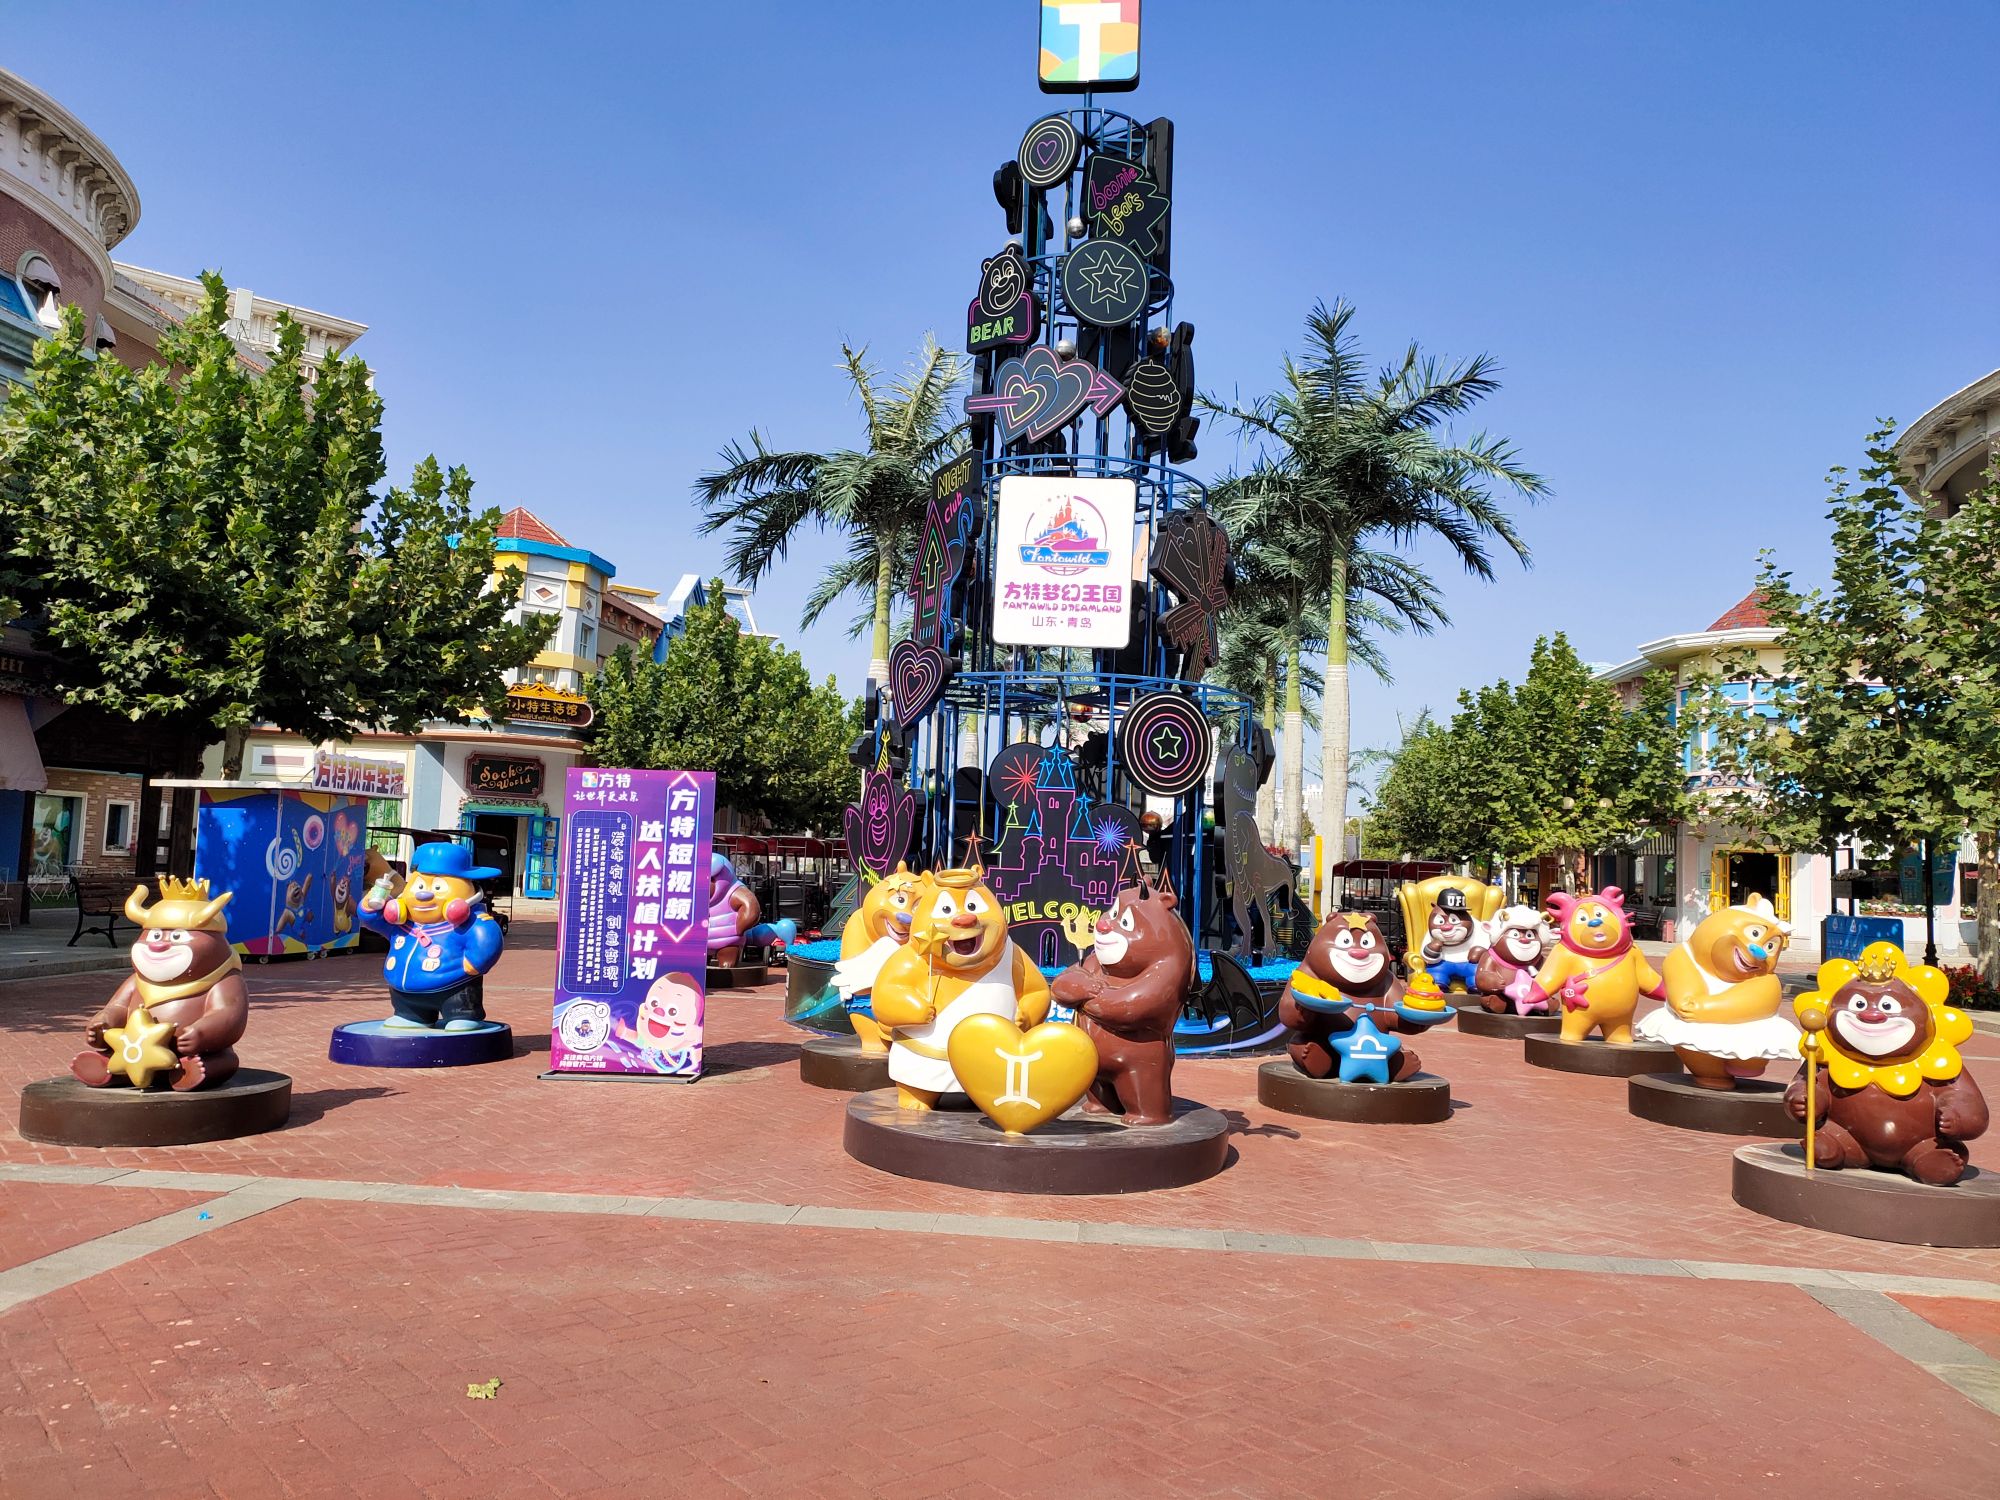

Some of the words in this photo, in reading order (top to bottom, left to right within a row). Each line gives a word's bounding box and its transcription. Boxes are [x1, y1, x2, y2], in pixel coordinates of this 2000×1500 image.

[1091, 167, 1137, 210] boonie
[1102, 192, 1145, 236] bears
[970, 316, 1014, 344] BEAR
[937, 458, 972, 499] NIGHT
[944, 492, 962, 524] Club
[1024, 548, 1094, 563] Fantawild
[1004, 582, 1122, 603] 方特梦幻王国
[1003, 601, 1059, 611] FANTAWILD
[1061, 604, 1122, 613] DREAMLAND
[480, 764, 517, 782] Sock
[496, 774, 531, 790] World
[599, 773, 632, 789] 方特
[573, 791, 639, 806] 让世界更欢乐
[664, 789, 697, 920] 方特短视频
[630, 820, 664, 980] 达人扶植计划
[1003, 901, 1101, 926] ELCOM
